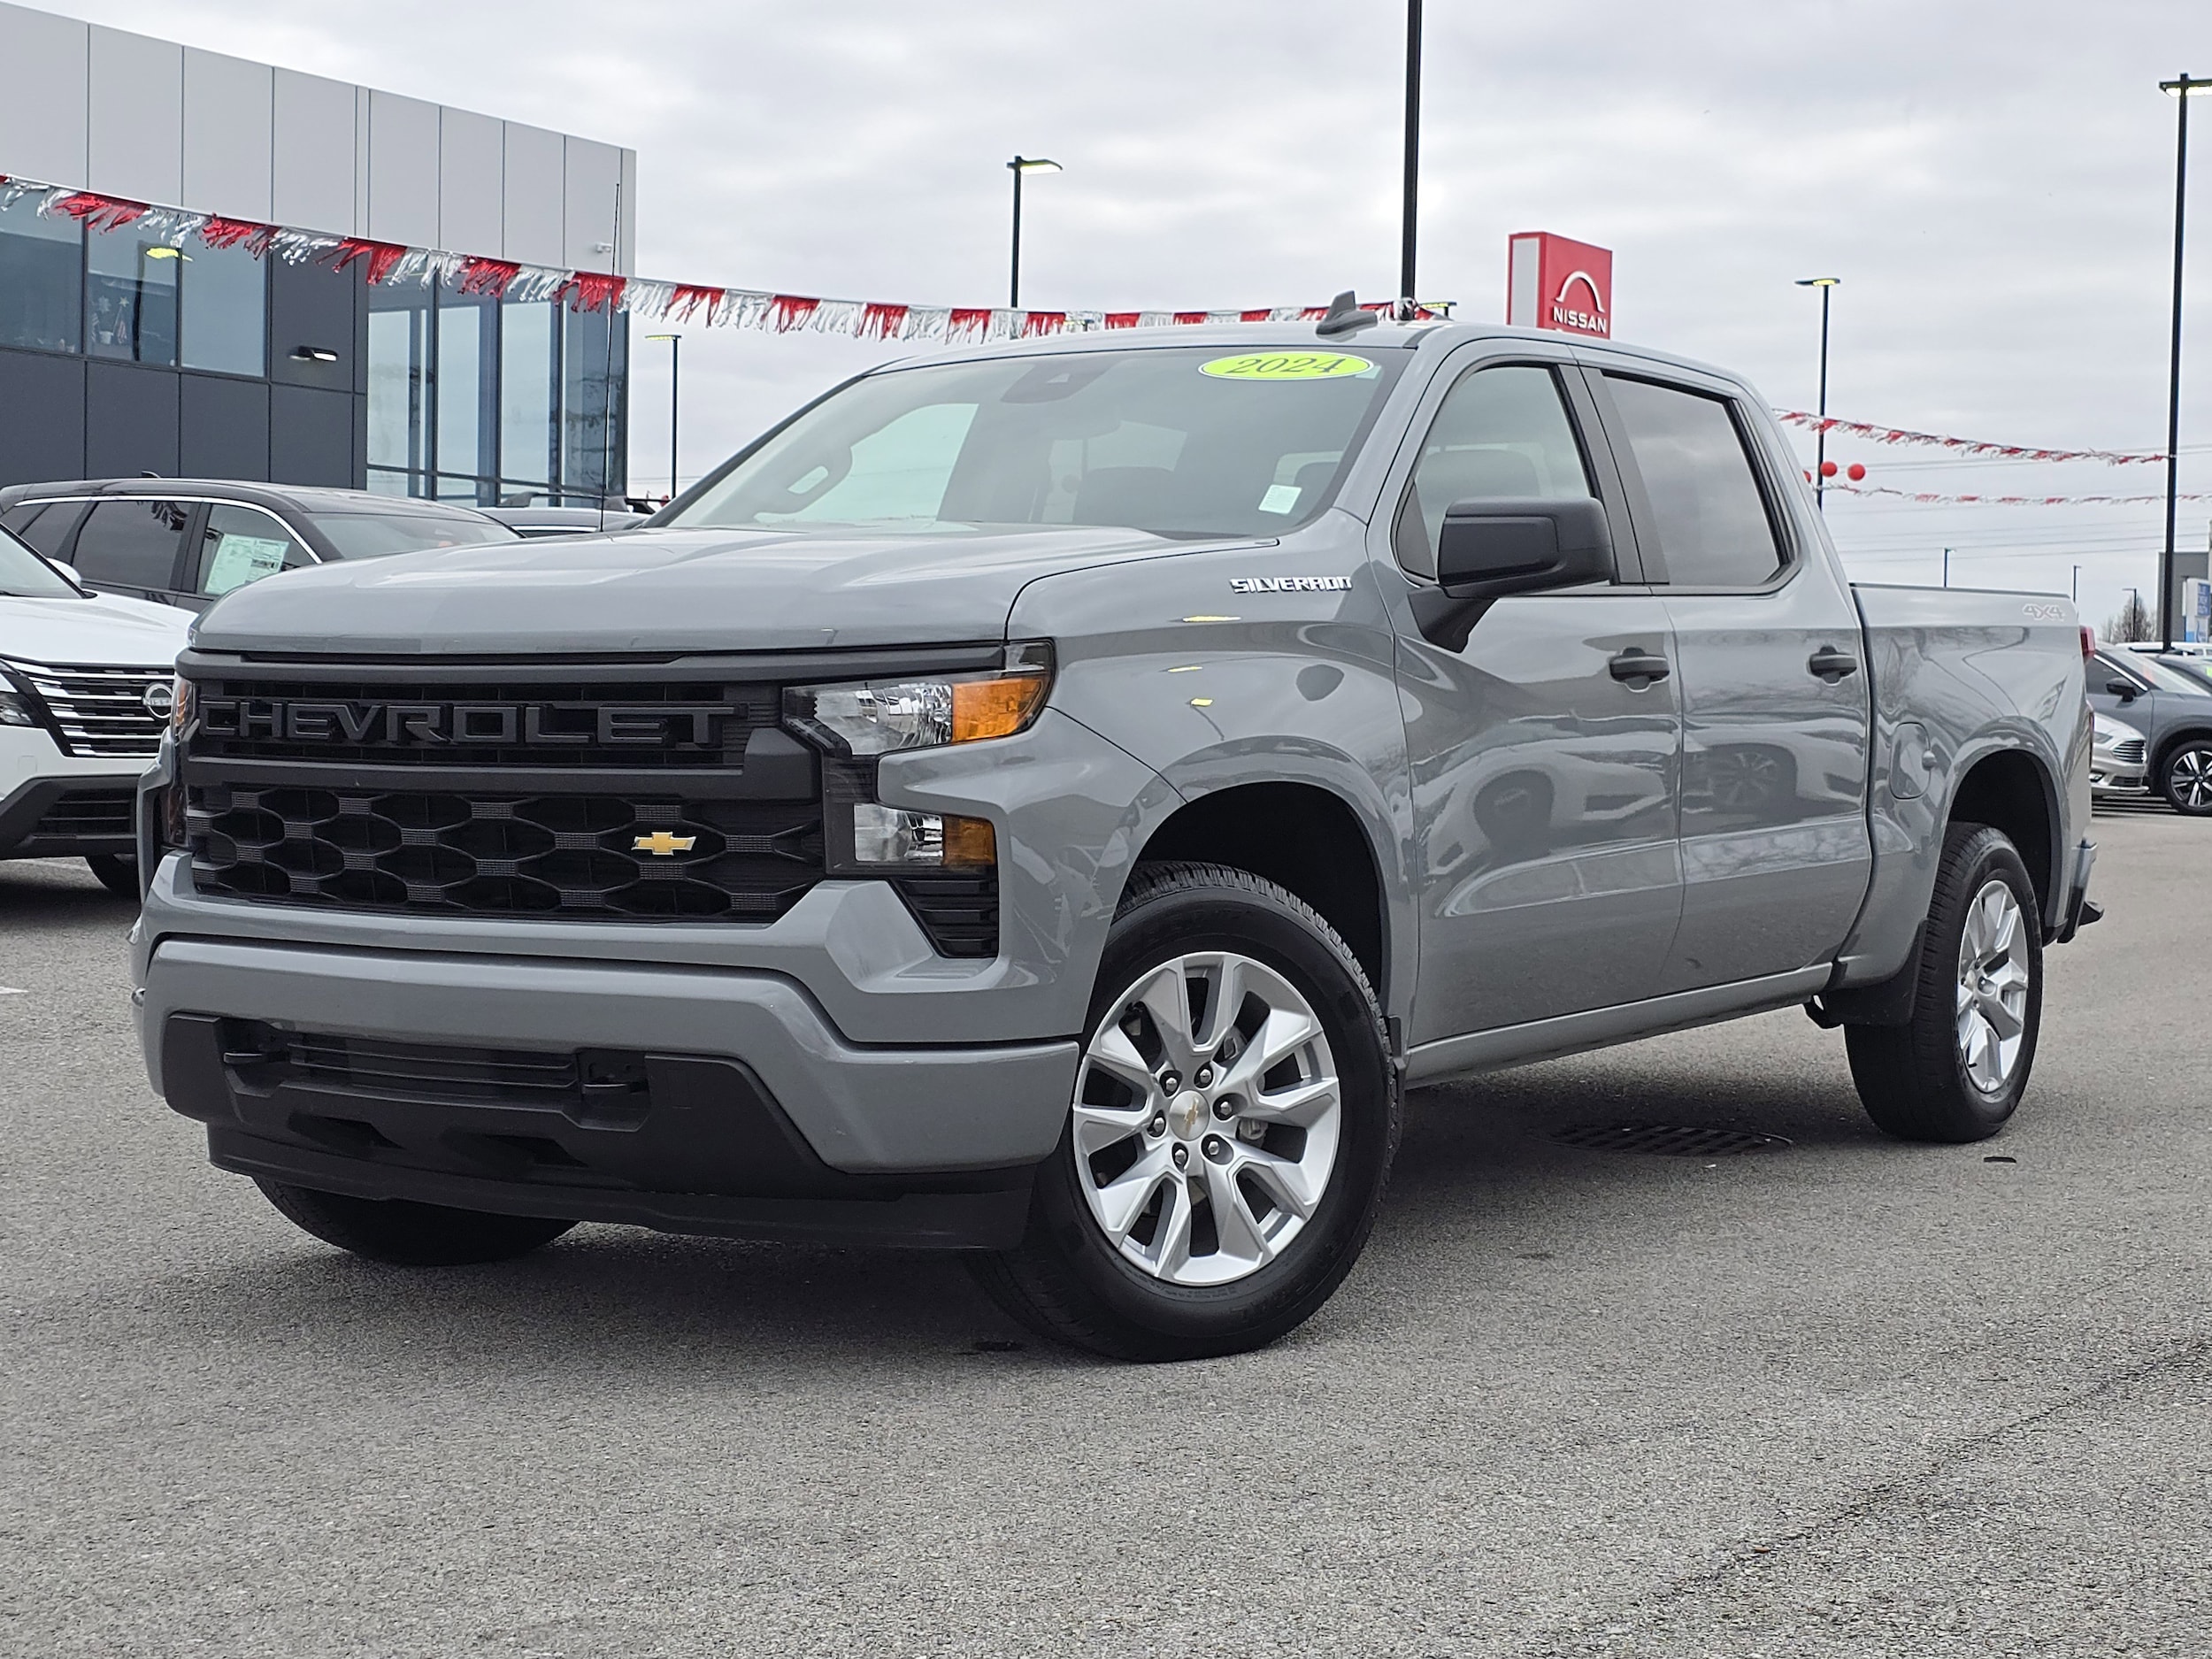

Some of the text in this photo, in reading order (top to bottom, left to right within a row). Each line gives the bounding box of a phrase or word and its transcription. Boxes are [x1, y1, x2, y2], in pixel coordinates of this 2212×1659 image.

[1552, 305, 1607, 334] NISSAN
[1225, 357, 1346, 373] 2024
[1229, 576, 1353, 593] SILVERADO
[199, 700, 735, 746] CHEVROLET
